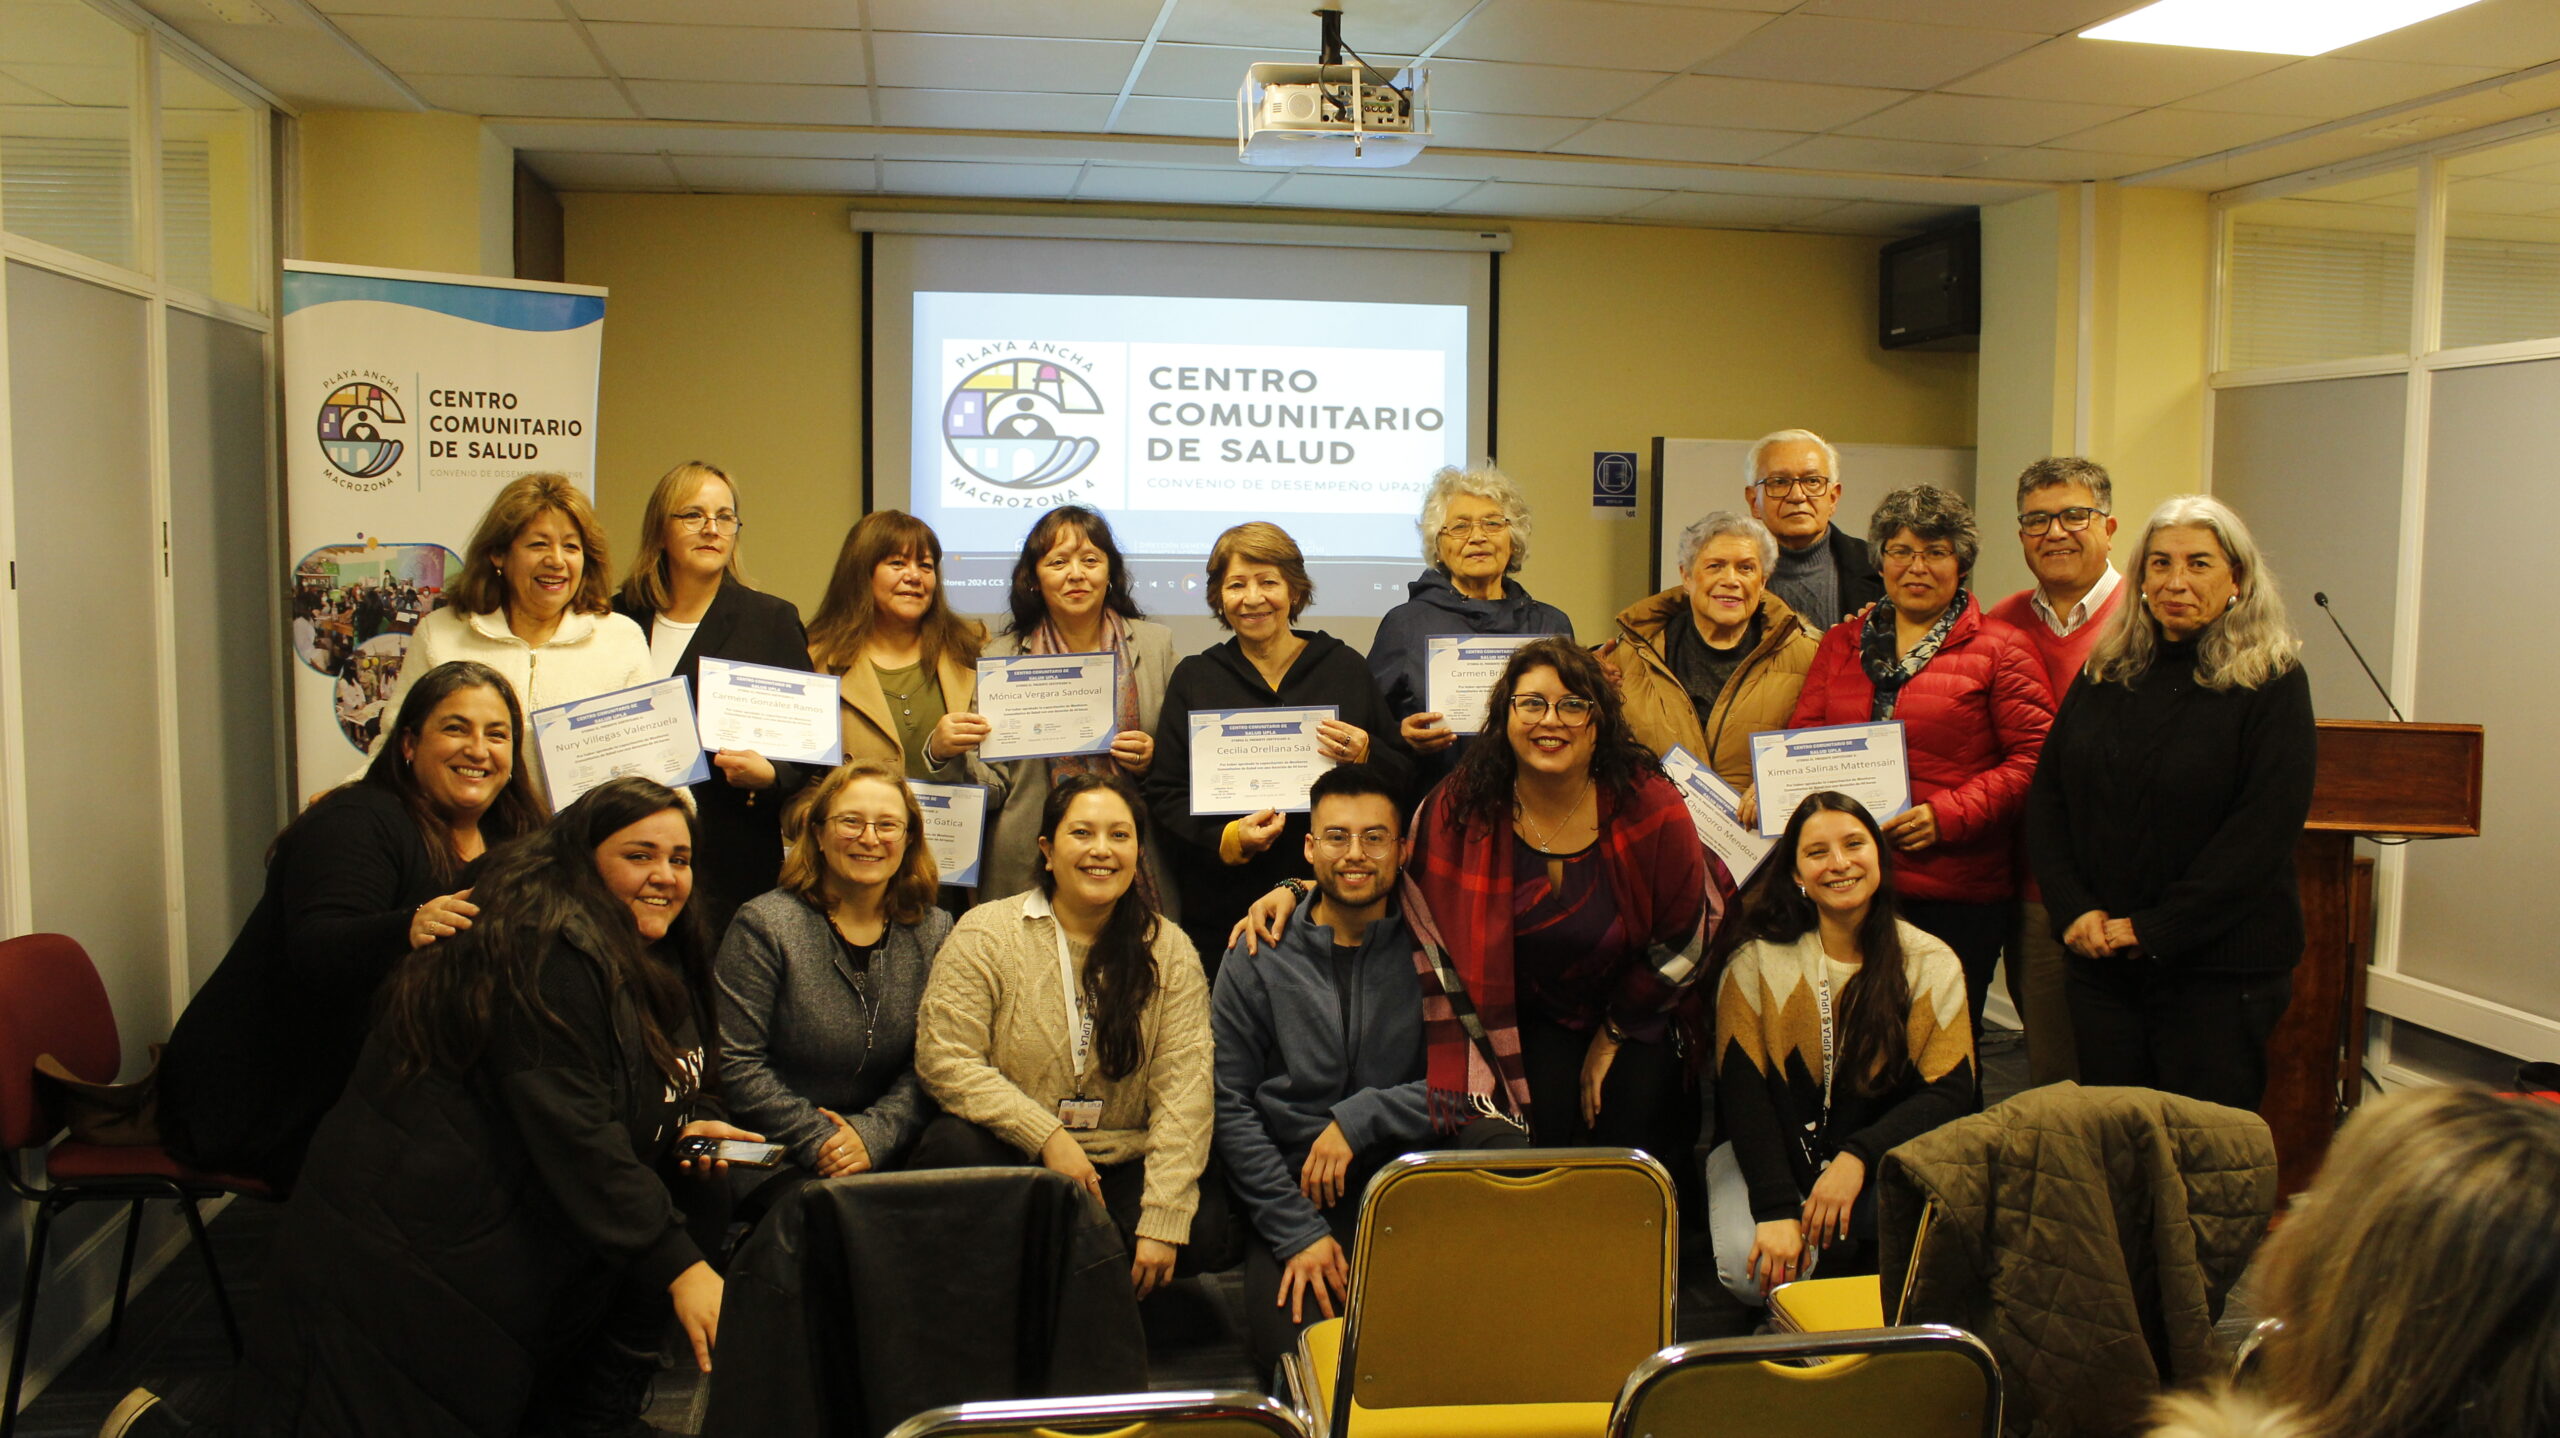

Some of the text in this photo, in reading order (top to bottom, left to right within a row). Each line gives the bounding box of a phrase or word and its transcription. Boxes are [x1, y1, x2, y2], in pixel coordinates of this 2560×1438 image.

[955, 341, 1094, 373] PLAYA ANCHA
[322, 369, 399, 394] PLAYA ANCHA
[1148, 365, 1318, 393] CENTRO
[429, 389, 518, 410] CENTRO
[429, 415, 582, 437] COMUNITARIO
[1148, 402, 1445, 432] COMUNITARIO
[430, 440, 538, 460] DE SALUD
[1147, 438, 1355, 465] DE SALUD
[323, 469, 393, 492] MACROZONA
[430, 469, 477, 478] CONVENIO
[480, 470, 492, 478] DE
[1147, 477, 1236, 489] CONVENIO
[1242, 479, 1264, 490] DE
[1271, 478, 1372, 492] DESEMPEÑO
[950, 477, 1095, 508] MACROZONA 4
[967, 578, 987, 587] 2024
[988, 579, 1004, 587] CCS
[1451, 670, 1487, 678] Carmen
[712, 691, 748, 704] Carmen
[750, 697, 791, 710] González
[793, 703, 823, 714] Ramos
[988, 687, 1102, 701] Mónica Vergara Sandoval
[555, 739, 581, 753] Nury
[582, 730, 621, 746] Villegas
[623, 716, 678, 735] Valenzuela
[1217, 743, 1311, 755] Cecilia Orellana Saá
[1767, 767, 1803, 777] Ximena
[1805, 763, 1839, 774] Salinas
[1841, 758, 1896, 771] Mattensain
[934, 817, 963, 827] Gatica
[1686, 800, 1723, 832] Chamorro
[1723, 829, 1758, 861] Mendoza
[1820, 989, 1830, 1015] UPLA
[1080, 1022, 1092, 1047] UPLA
[1823, 1026, 1832, 1052] UPLA
